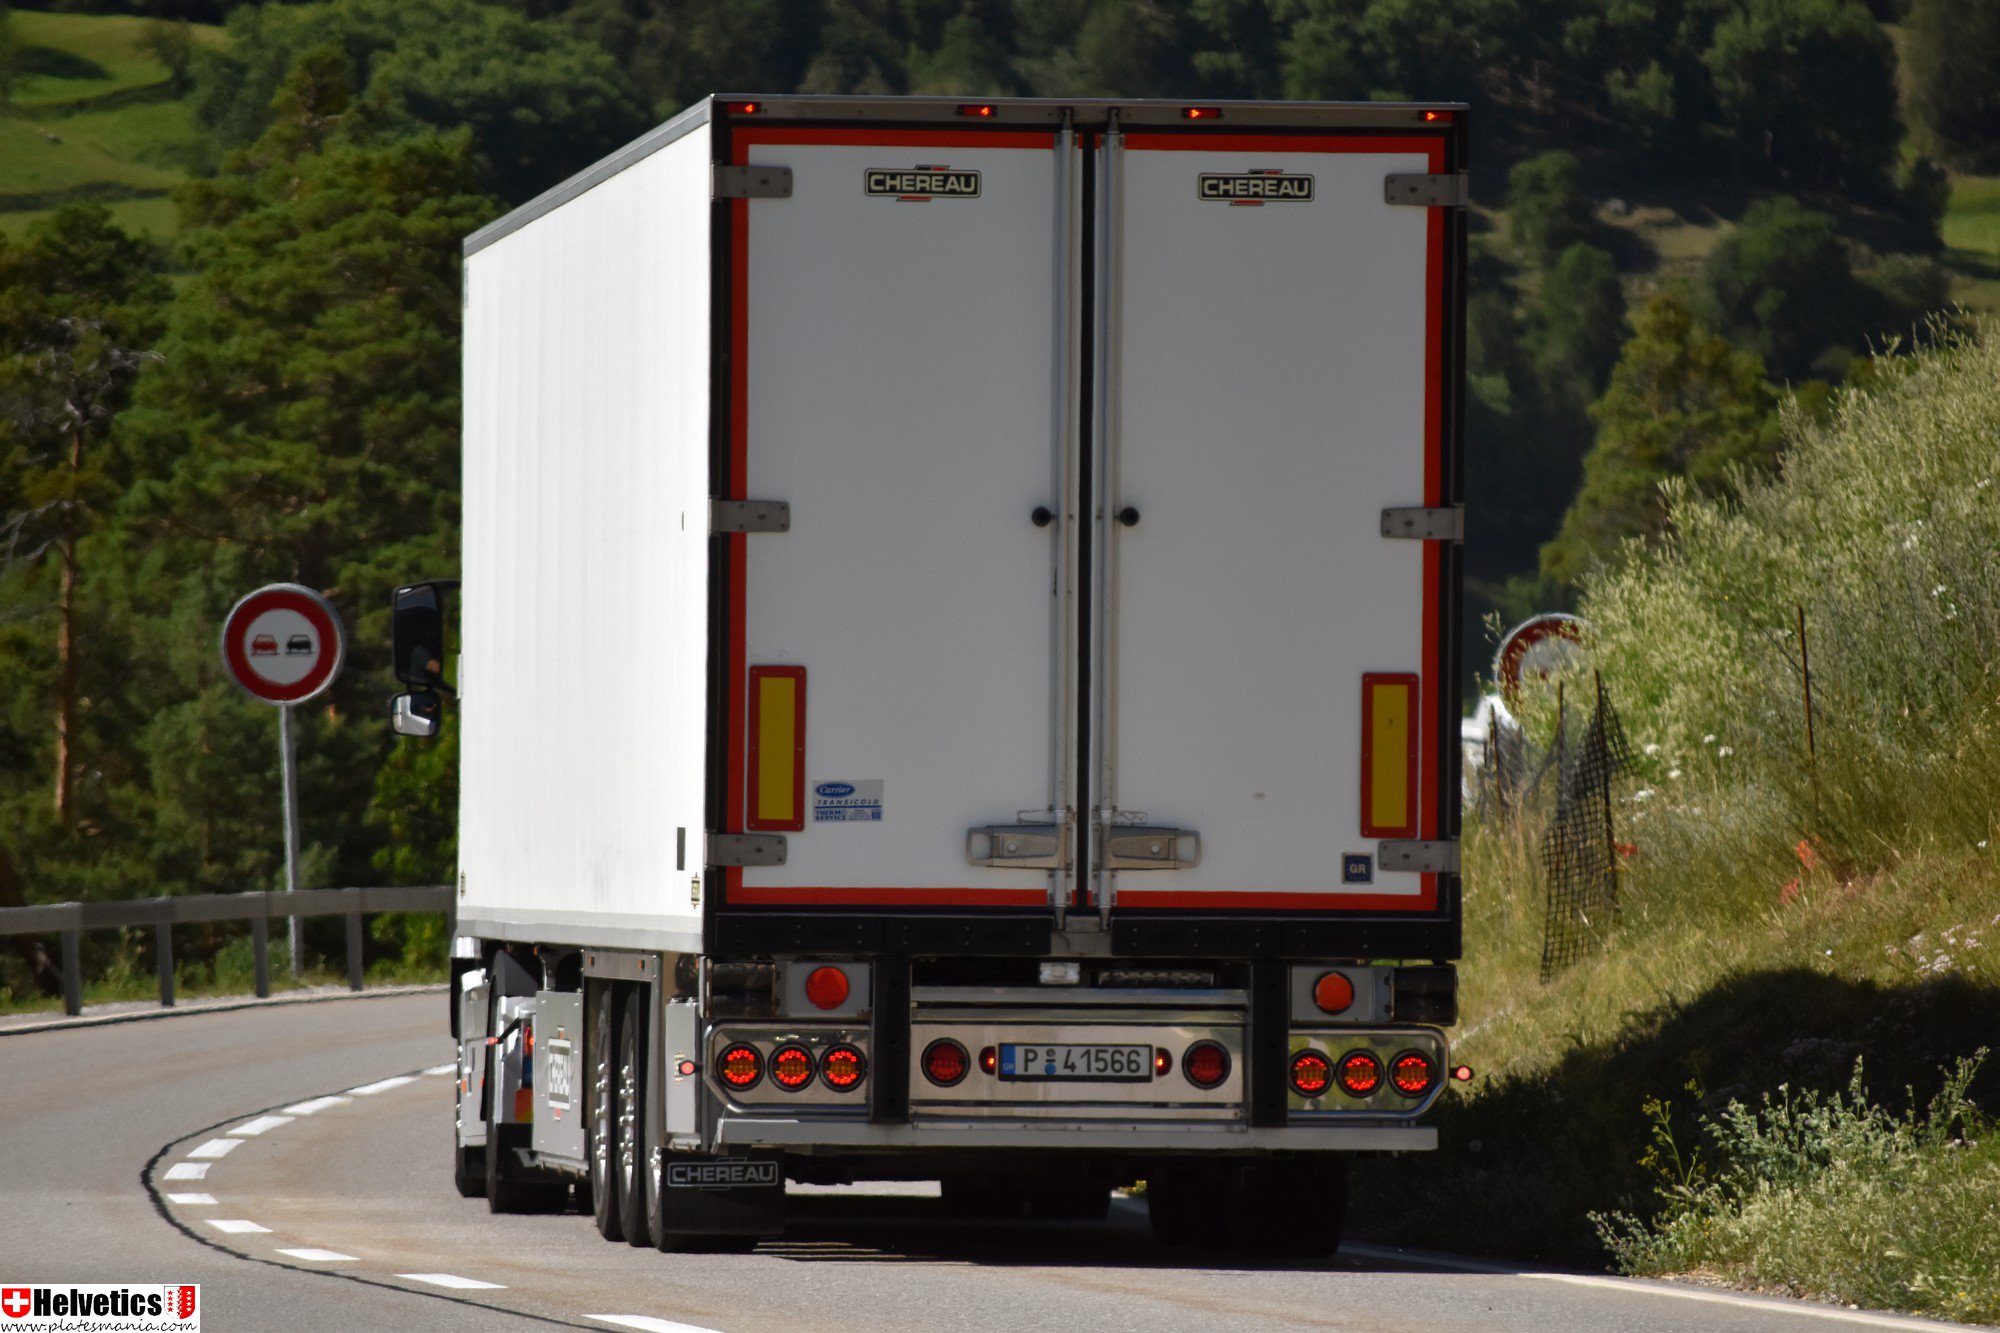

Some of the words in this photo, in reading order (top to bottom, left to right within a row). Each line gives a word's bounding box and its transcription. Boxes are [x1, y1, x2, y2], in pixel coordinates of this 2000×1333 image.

[870, 174, 976, 193] CHEREAU
[1203, 179, 1310, 196] CHEREAU
[819, 785, 852, 794] Carrier
[1350, 863, 1367, 874] GR
[1003, 1062, 1014, 1071] GR
[1024, 1048, 1038, 1073] P
[1063, 1048, 1141, 1074] 41566
[672, 1165, 774, 1183] CHEREAU
